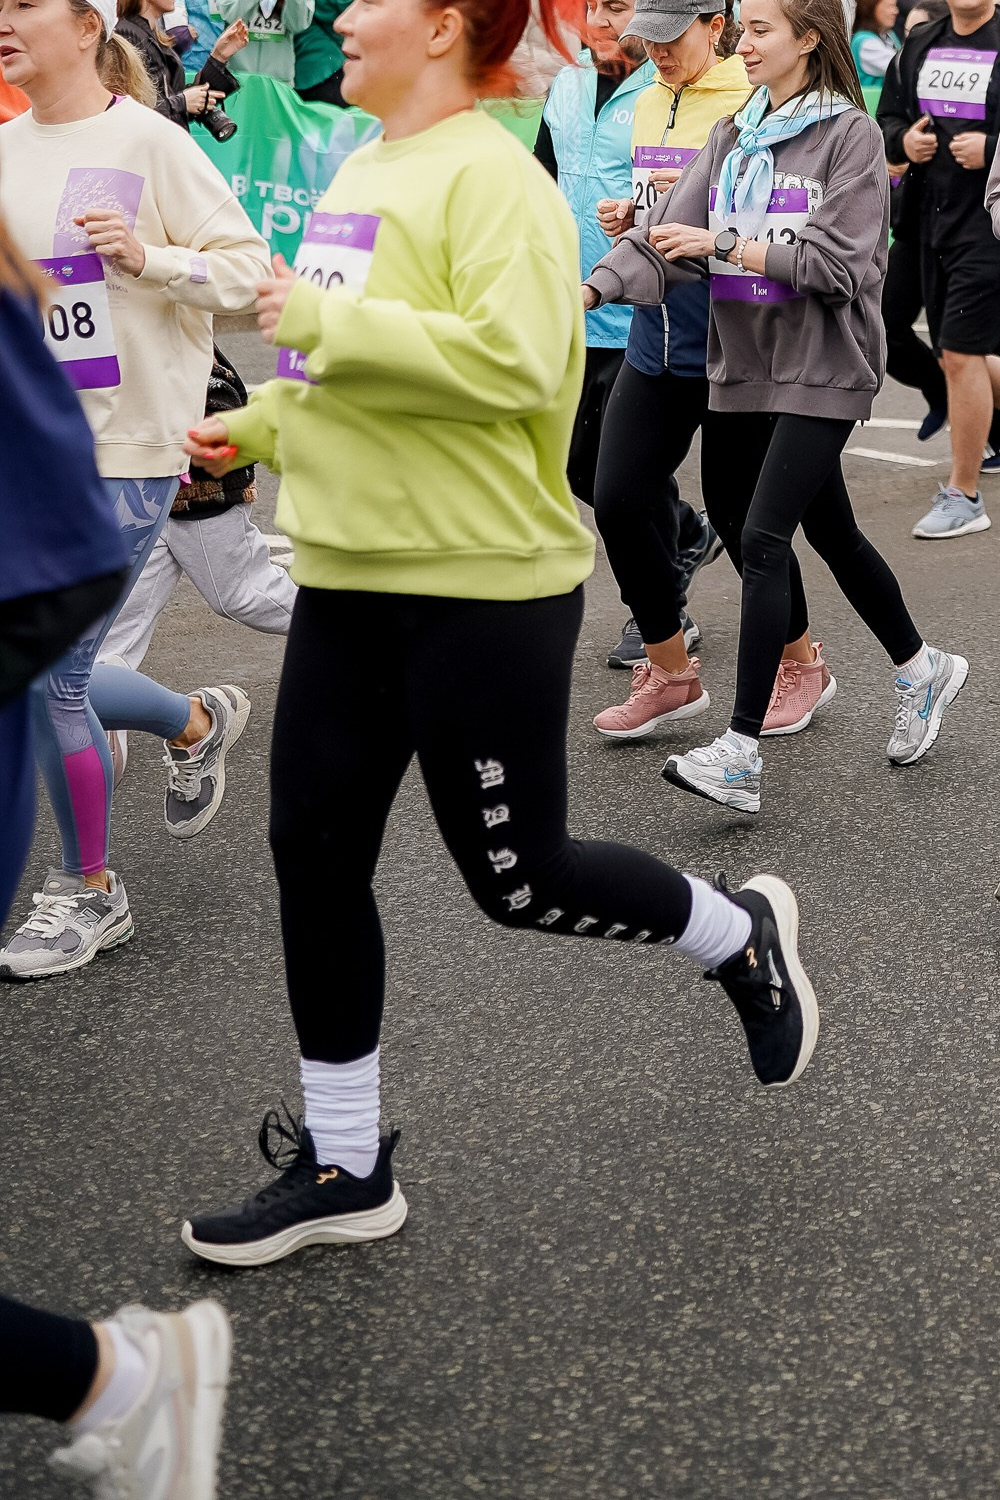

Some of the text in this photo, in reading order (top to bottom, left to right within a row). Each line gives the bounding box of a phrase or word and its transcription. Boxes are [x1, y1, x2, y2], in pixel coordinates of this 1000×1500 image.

[928, 70, 980, 92] 2049
[231, 175, 247, 197] В
[751, 283, 768, 297] 1км
